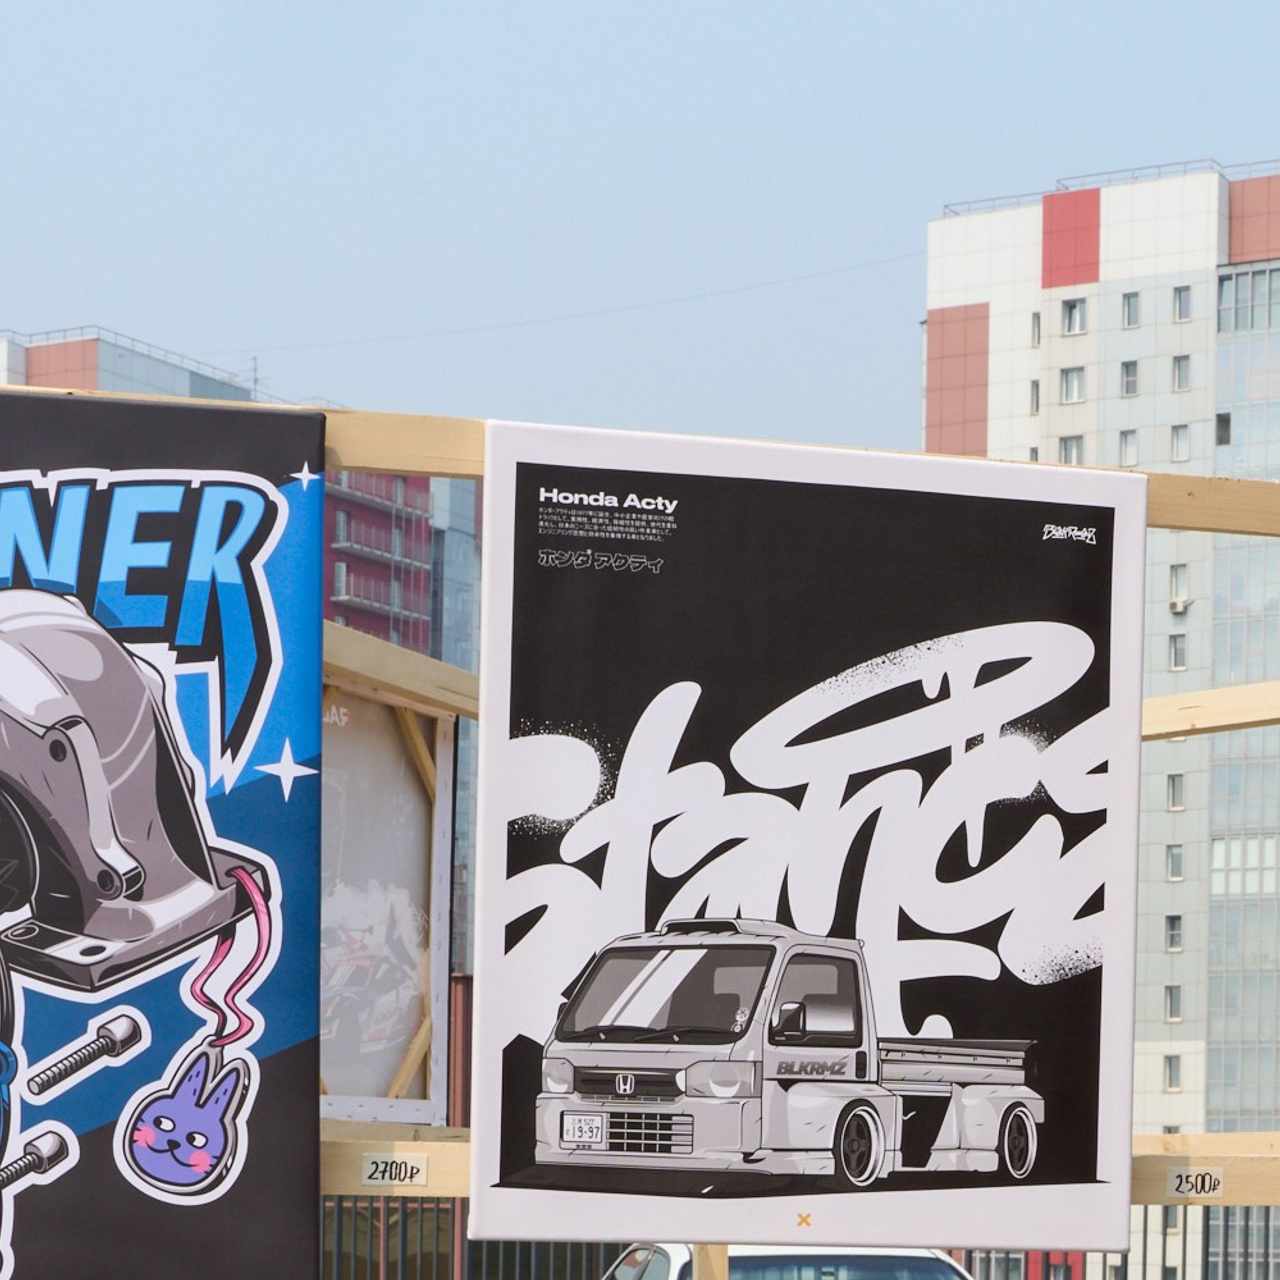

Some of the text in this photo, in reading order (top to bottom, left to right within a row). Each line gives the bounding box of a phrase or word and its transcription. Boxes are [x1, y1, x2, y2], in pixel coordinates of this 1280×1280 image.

[539, 487, 678, 514] Honda Acty
[776, 1061, 846, 1076] BLKRMZ
